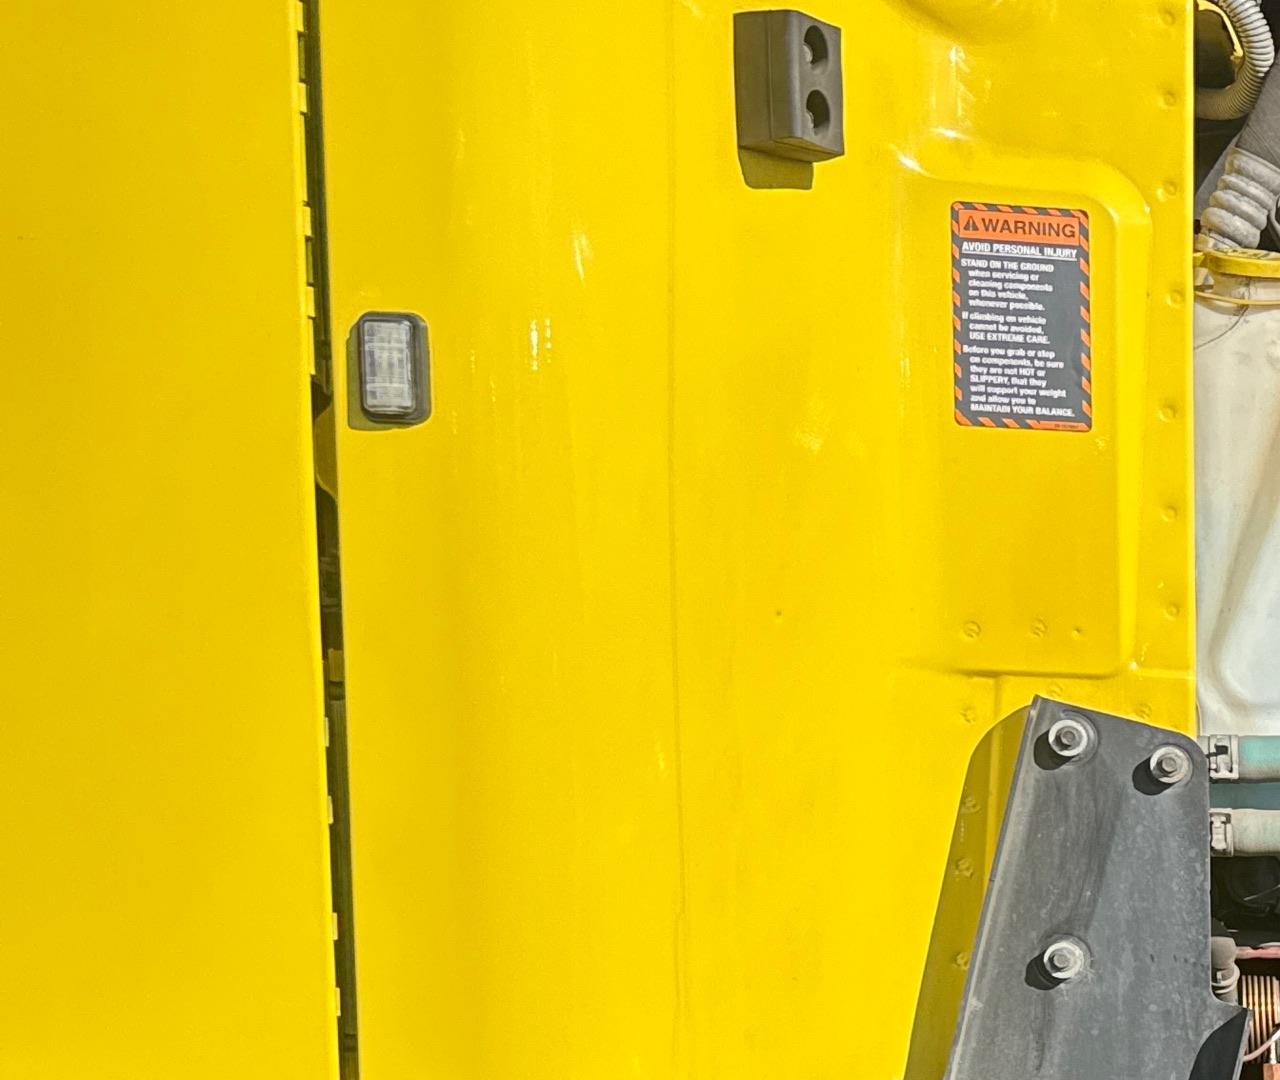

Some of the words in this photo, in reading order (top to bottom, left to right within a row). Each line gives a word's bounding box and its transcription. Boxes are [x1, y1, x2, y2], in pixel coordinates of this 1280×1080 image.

[982, 218, 1076, 237] WARNING
[962, 242, 990, 252] AVOID
[993, 245, 1041, 255] PERSONAL
[1044, 248, 1077, 258] INJURY
[961, 259, 988, 267] STAND
[990, 260, 1001, 268] ON
[1003, 261, 1018, 269] THE
[1020, 262, 1054, 272] GROUND
[970, 332, 985, 340] USE
[987, 333, 1024, 343] EXTREME
[1019, 368, 1034, 376] HOT
[970, 404, 1010, 413] MAINTAIN
[1012, 406, 1033, 415] YOUR
